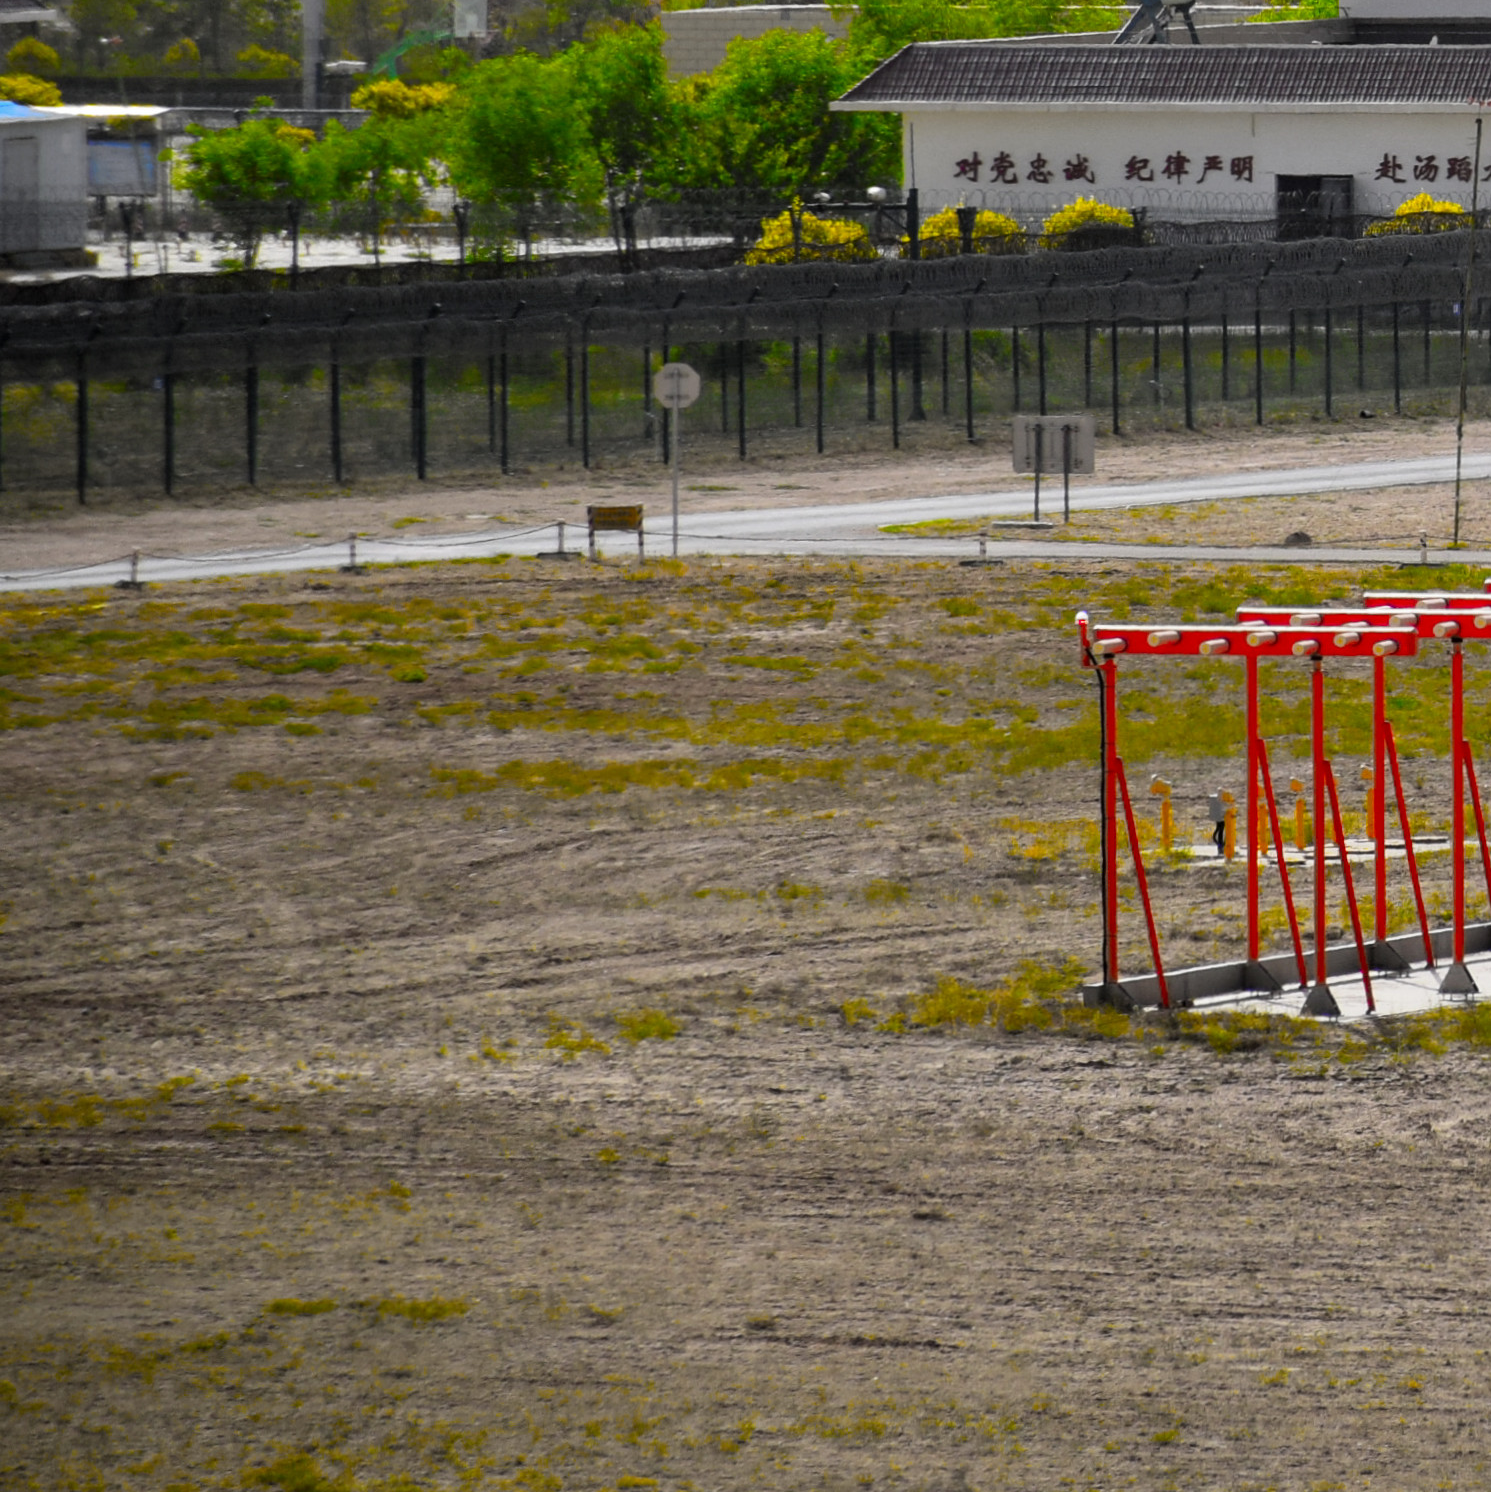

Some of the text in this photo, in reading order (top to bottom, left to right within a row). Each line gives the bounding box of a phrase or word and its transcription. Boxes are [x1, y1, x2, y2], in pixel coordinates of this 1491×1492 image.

[953, 151, 1096, 184] 对党忠诚
[1125, 151, 1254, 184] 纪律严明
